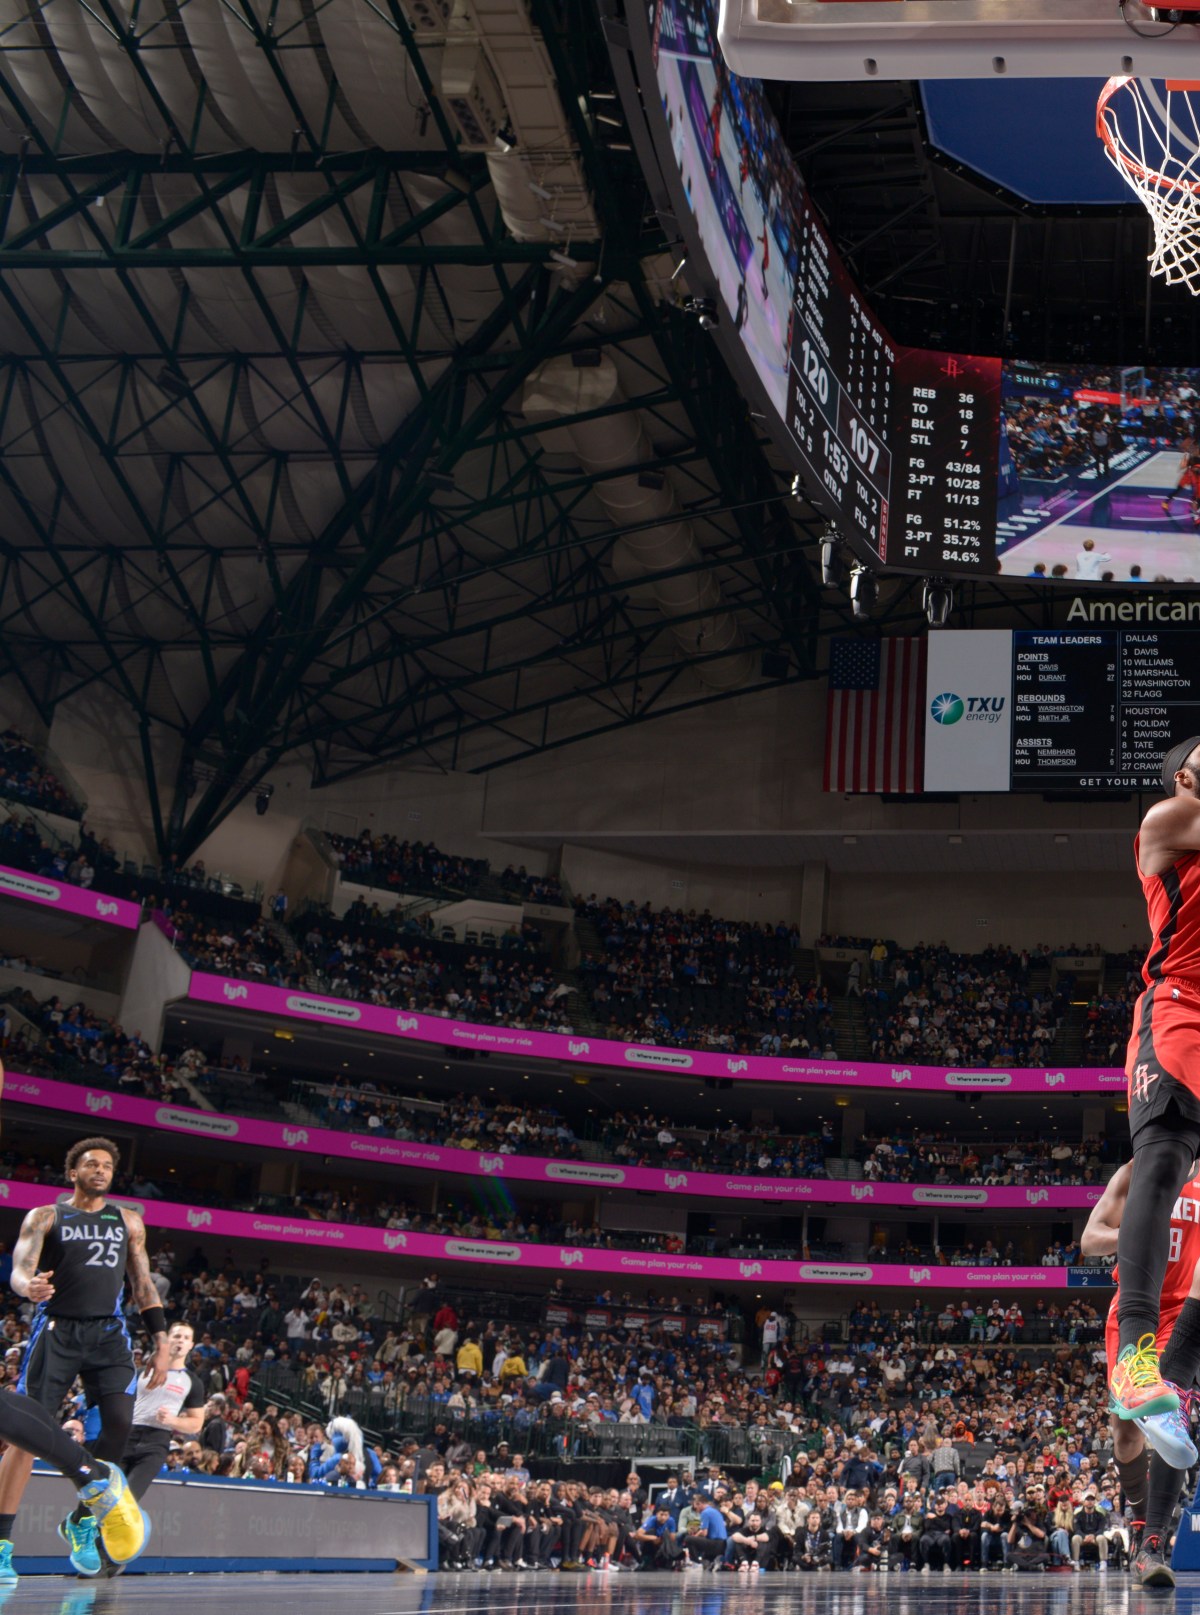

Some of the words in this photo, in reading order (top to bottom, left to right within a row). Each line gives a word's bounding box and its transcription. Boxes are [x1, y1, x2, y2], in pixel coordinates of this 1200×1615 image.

[802, 340, 828, 405] 120
[796, 386, 806, 414] TOL
[913, 387, 936, 399] REB
[958, 393, 974, 404] 36
[912, 403, 928, 414] TO
[959, 409, 974, 420] 18
[794, 415, 805, 440] FLS
[911, 418, 935, 431] BLK
[961, 425, 969, 435] 6
[850, 418, 879, 475] 107
[910, 434, 931, 446] STL
[960, 440, 968, 450] 7
[823, 430, 848, 484] 1:53
[909, 457, 925, 469] FG
[945, 461, 981, 474] 43/84
[824, 469, 838, 496] QTR
[908, 473, 935, 486] 3-PT
[946, 477, 980, 490] 10/28
[856, 480, 869, 505] TOL
[907, 489, 922, 500] FT
[945, 493, 980, 505] 11/13
[855, 506, 867, 529] FLS
[906, 514, 922, 525] FG
[944, 518, 981, 531] 51.2%
[905, 530, 932, 542] 3-PT
[943, 534, 980, 547] 35.7%
[905, 546, 919, 557] FT
[942, 550, 980, 563] 84.6%
[1060, 636, 1102, 644] LEADERS
[1018, 653, 1049, 661] POINTS
[1134, 669, 1179, 677] MARSHALL
[1017, 694, 1066, 702] REBOUNDS
[1134, 690, 1162, 698] FLAGG
[967, 697, 1005, 712] TXU
[1125, 707, 1167, 715] HOUSTON
[966, 713, 1002, 724] energy
[452, 1028, 475, 1040] Game
[350, 1140, 378, 1153] Game
[379, 1145, 399, 1158] plan
[401, 1149, 421, 1160] your
[423, 1151, 440, 1161] ride
[61, 1225, 124, 1242] DALLAS
[253, 1221, 281, 1233] Game
[283, 1224, 303, 1236] plan
[305, 1228, 325, 1238] your
[326, 1229, 344, 1240] ride
[1168, 1227, 1183, 1262] 8
[85, 1242, 121, 1268] 25
[966, 1273, 991, 1281] Game
[992, 1273, 1011, 1283] plan
[1011, 1274, 1029, 1282] your
[1030, 1273, 1046, 1281] ride
[1082, 1277, 1088, 1285] 2
